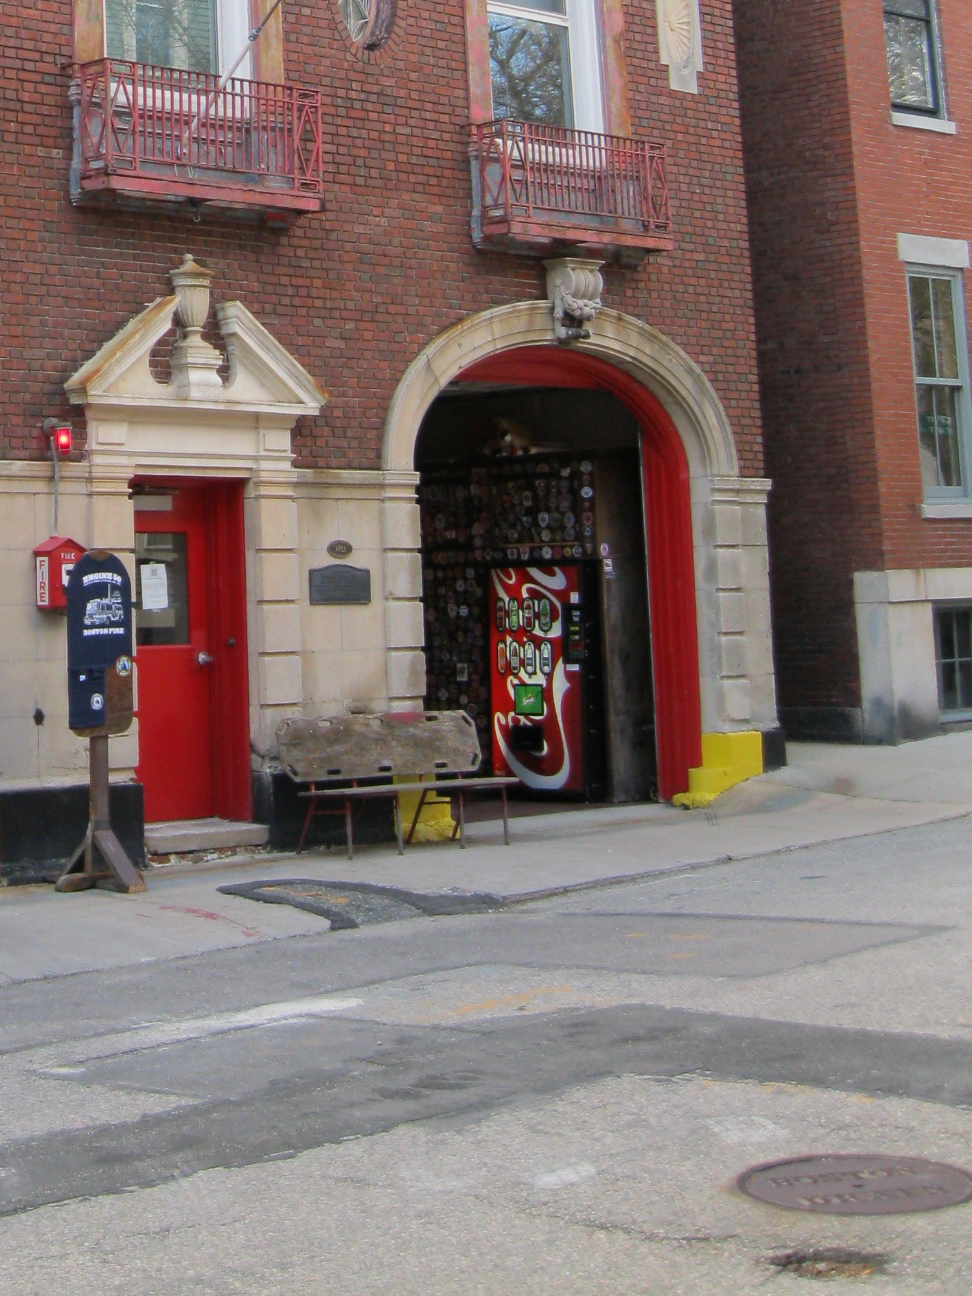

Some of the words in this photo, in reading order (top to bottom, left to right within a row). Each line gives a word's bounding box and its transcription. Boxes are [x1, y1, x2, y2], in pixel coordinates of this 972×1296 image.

[60, 552, 75, 560] FIRE
[82, 572, 112, 583] ENGINE
[112, 572, 122, 583] 50
[83, 627, 108, 636] BOSTON
[109, 627, 124, 635] FIRE
